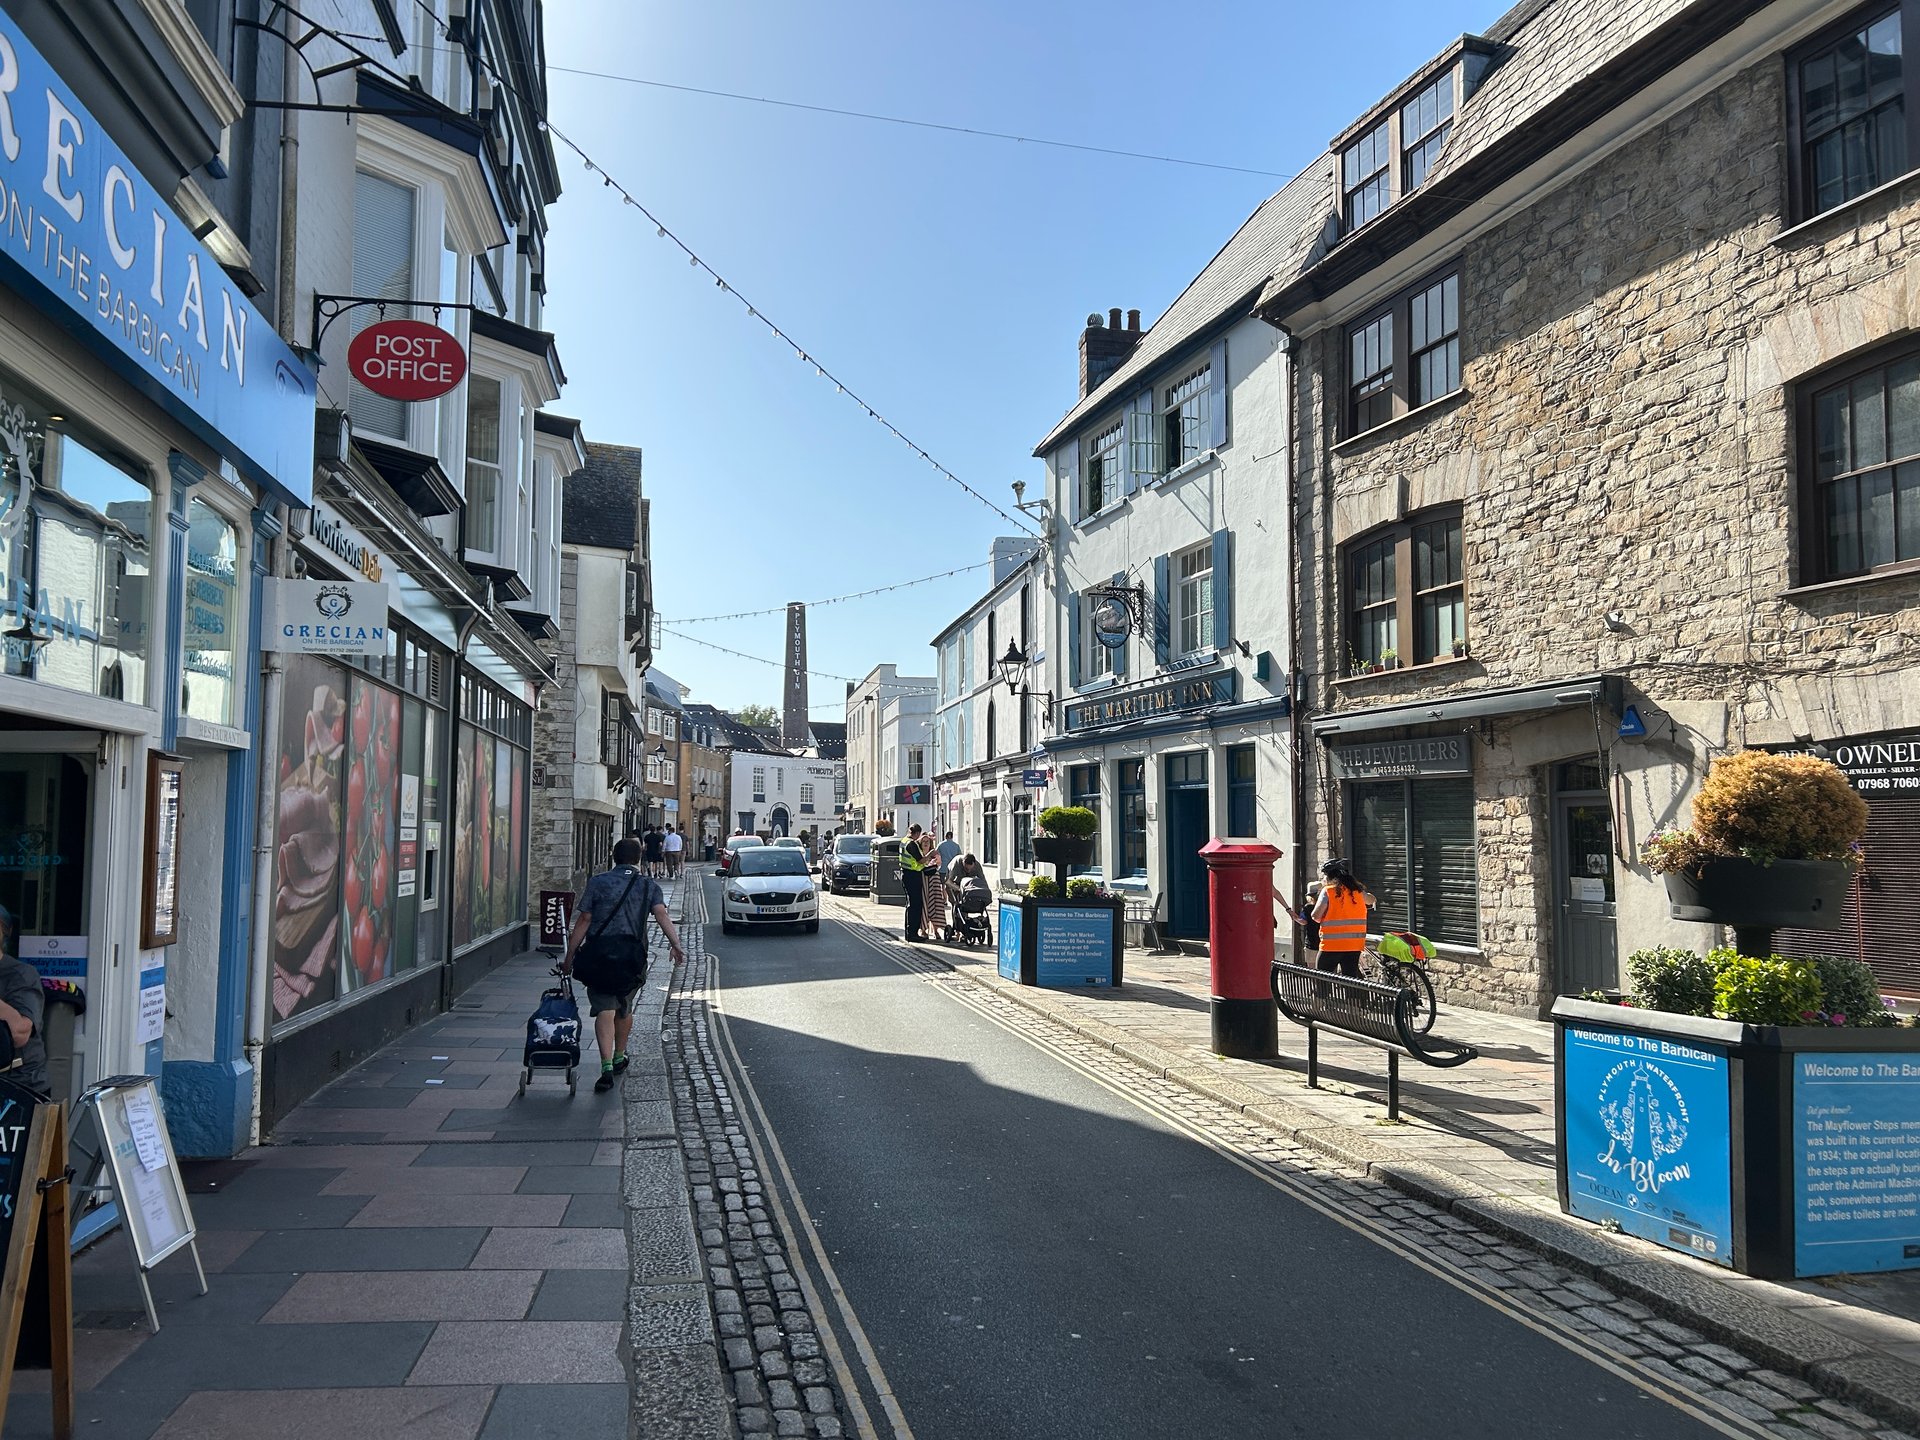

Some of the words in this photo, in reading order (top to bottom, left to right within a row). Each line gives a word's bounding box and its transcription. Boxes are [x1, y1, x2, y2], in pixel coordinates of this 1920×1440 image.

[39, 215, 92, 303] THE
[98, 271, 200, 400] BARBICAN
[375, 334, 442, 359] POST
[362, 357, 453, 383] OFFICE
[283, 624, 383, 640] GRECIAN
[1076, 704, 1100, 724] THE
[1105, 688, 1176, 718] MARITIME
[1183, 680, 1213, 704] INN
[200, 723, 241, 745] RESTAURANT
[1364, 740, 1458, 765] JEWELLERS
[1848, 767, 1887, 775] JEWELLERY
[1857, 778, 1890, 789] 07968
[1891, 777, 1920, 788] 7060
[544, 897, 558, 934] COSTA
[1573, 1028, 1621, 1046] Welcome
[1622, 1035, 1635, 1048] to
[1636, 1037, 1658, 1052] The
[1661, 1041, 1717, 1062] Barbican
[1804, 1063, 1859, 1077] Welcome
[1861, 1064, 1874, 1077] to
[1876, 1063, 1899, 1077] The
[1598, 1059, 1636, 1101] PLYMOUTH
[1645, 1061, 1690, 1123] WATERFRONT
[1807, 1121, 1823, 1131] The
[1824, 1120, 1872, 1133] Mayflower
[1873, 1120, 1899, 1131] Steps
[1807, 1137, 1824, 1146] was
[1826, 1135, 1847, 1146] built
[1849, 1135, 1858, 1145] in
[1860, 1135, 1871, 1145] its
[1873, 1135, 1905, 1145] current
[1807, 1152, 1816, 1161] in
[1818, 1150, 1841, 1161] 1934;
[1843, 1150, 1858, 1160] the
[1860, 1149, 1894, 1162] original
[1597, 1139, 1622, 1174] In
[1623, 1156, 1690, 1194] Bloom
[1807, 1166, 1822, 1177] the
[1823, 1165, 1848, 1177] steps
[1850, 1167, 1865, 1175] are
[1867, 1163, 1901, 1175] actually
[1589, 1182, 1623, 1199] OCEAN
[1807, 1182, 1836, 1192] under
[1836, 1180, 1850, 1191] the
[1851, 1179, 1887, 1190] Admiral
[1807, 1196, 1828, 1209] pub,
[1829, 1195, 1881, 1206] somewhere
[1883, 1193, 1917, 1203] beneath
[1807, 1211, 1822, 1222] the
[1824, 1210, 1851, 1220] ladies
[1853, 1209, 1881, 1219] toilets
[1882, 1210, 1897, 1218] are
[1898, 1208, 1918, 1217] now.
